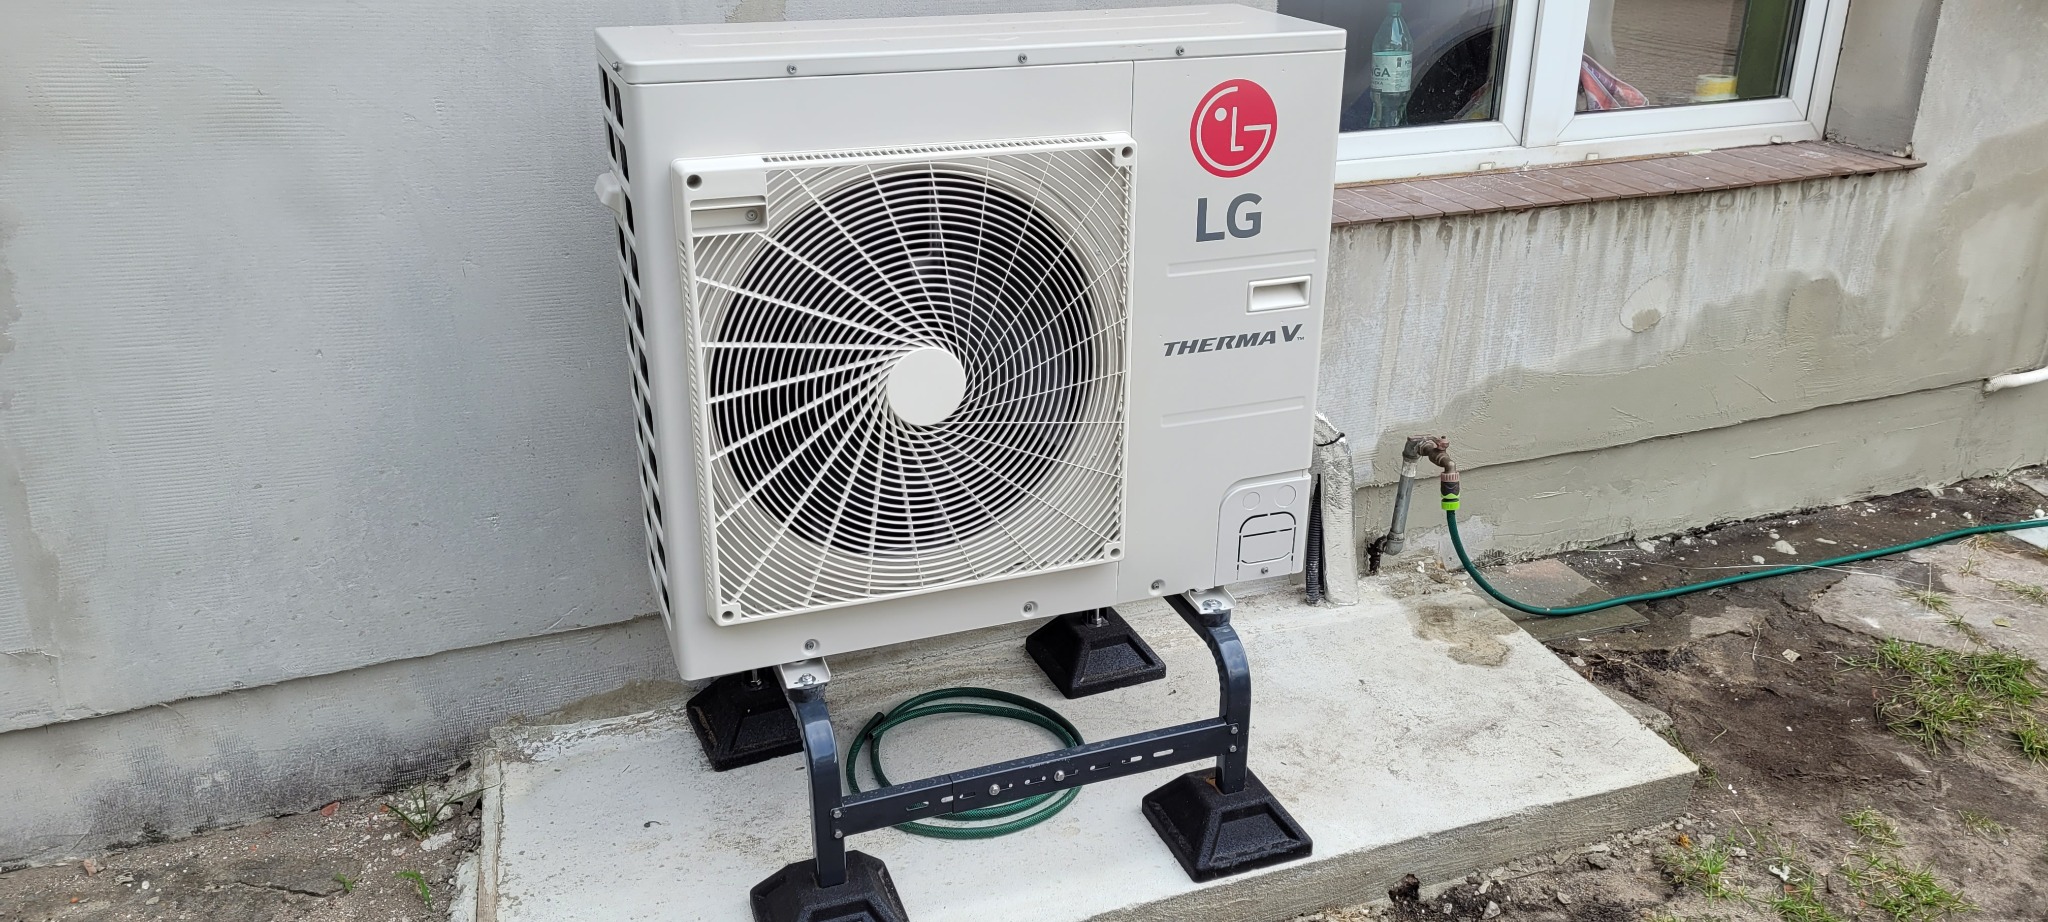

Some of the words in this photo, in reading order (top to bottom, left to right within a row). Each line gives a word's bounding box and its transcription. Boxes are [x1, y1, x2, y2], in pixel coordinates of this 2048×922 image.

[1196, 85, 1272, 172] LG
[1196, 193, 1263, 242] LG
[1164, 330, 1276, 357] THERMA
